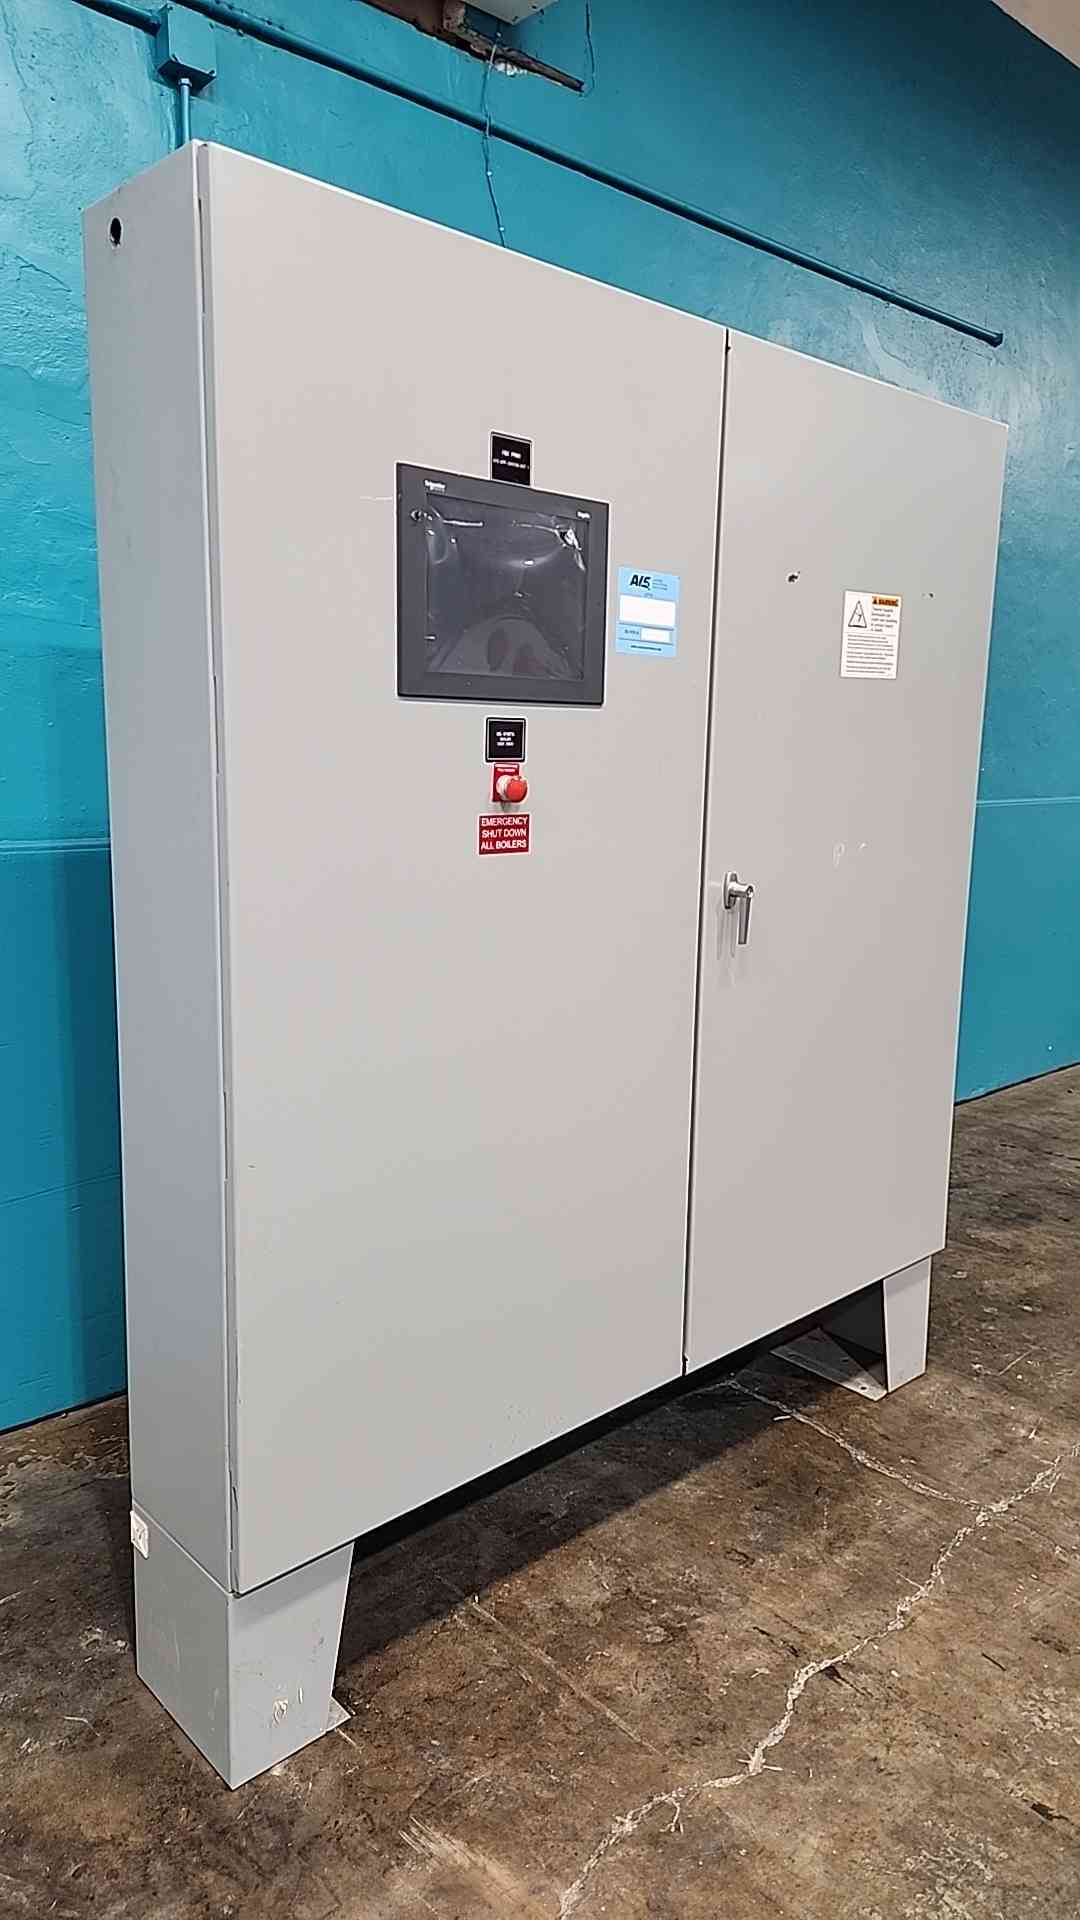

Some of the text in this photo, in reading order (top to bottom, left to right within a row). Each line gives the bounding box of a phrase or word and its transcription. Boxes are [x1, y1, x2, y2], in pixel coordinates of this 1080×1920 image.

[481, 816, 528, 826] EMERGENCY
[481, 828, 527, 838] SHUT DOWN
[480, 839, 527, 850] ALL BOILERS
